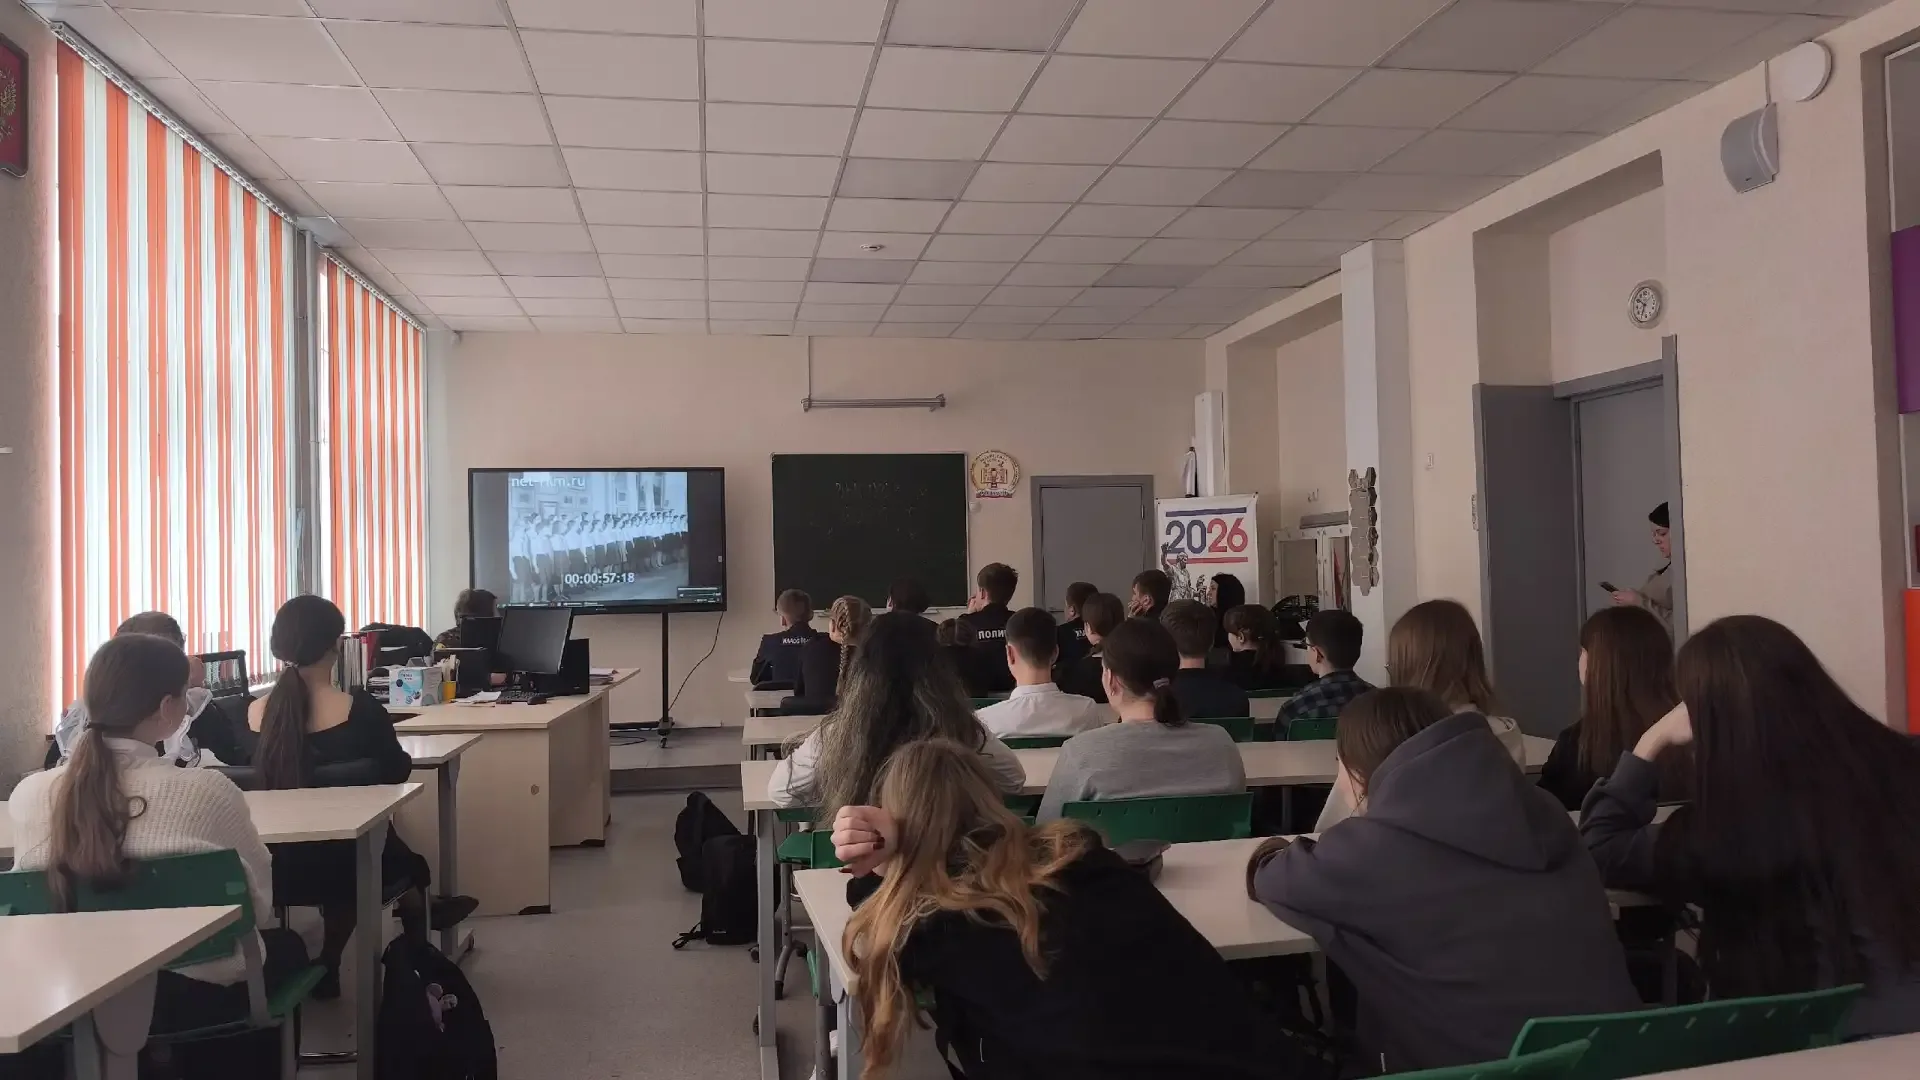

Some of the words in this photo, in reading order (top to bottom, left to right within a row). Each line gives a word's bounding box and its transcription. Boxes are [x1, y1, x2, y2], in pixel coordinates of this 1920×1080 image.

[1165, 517, 1249, 555] 2026
[564, 572, 635, 585] 00:00:57:18
[978, 629, 1007, 640] ПОЛИ
